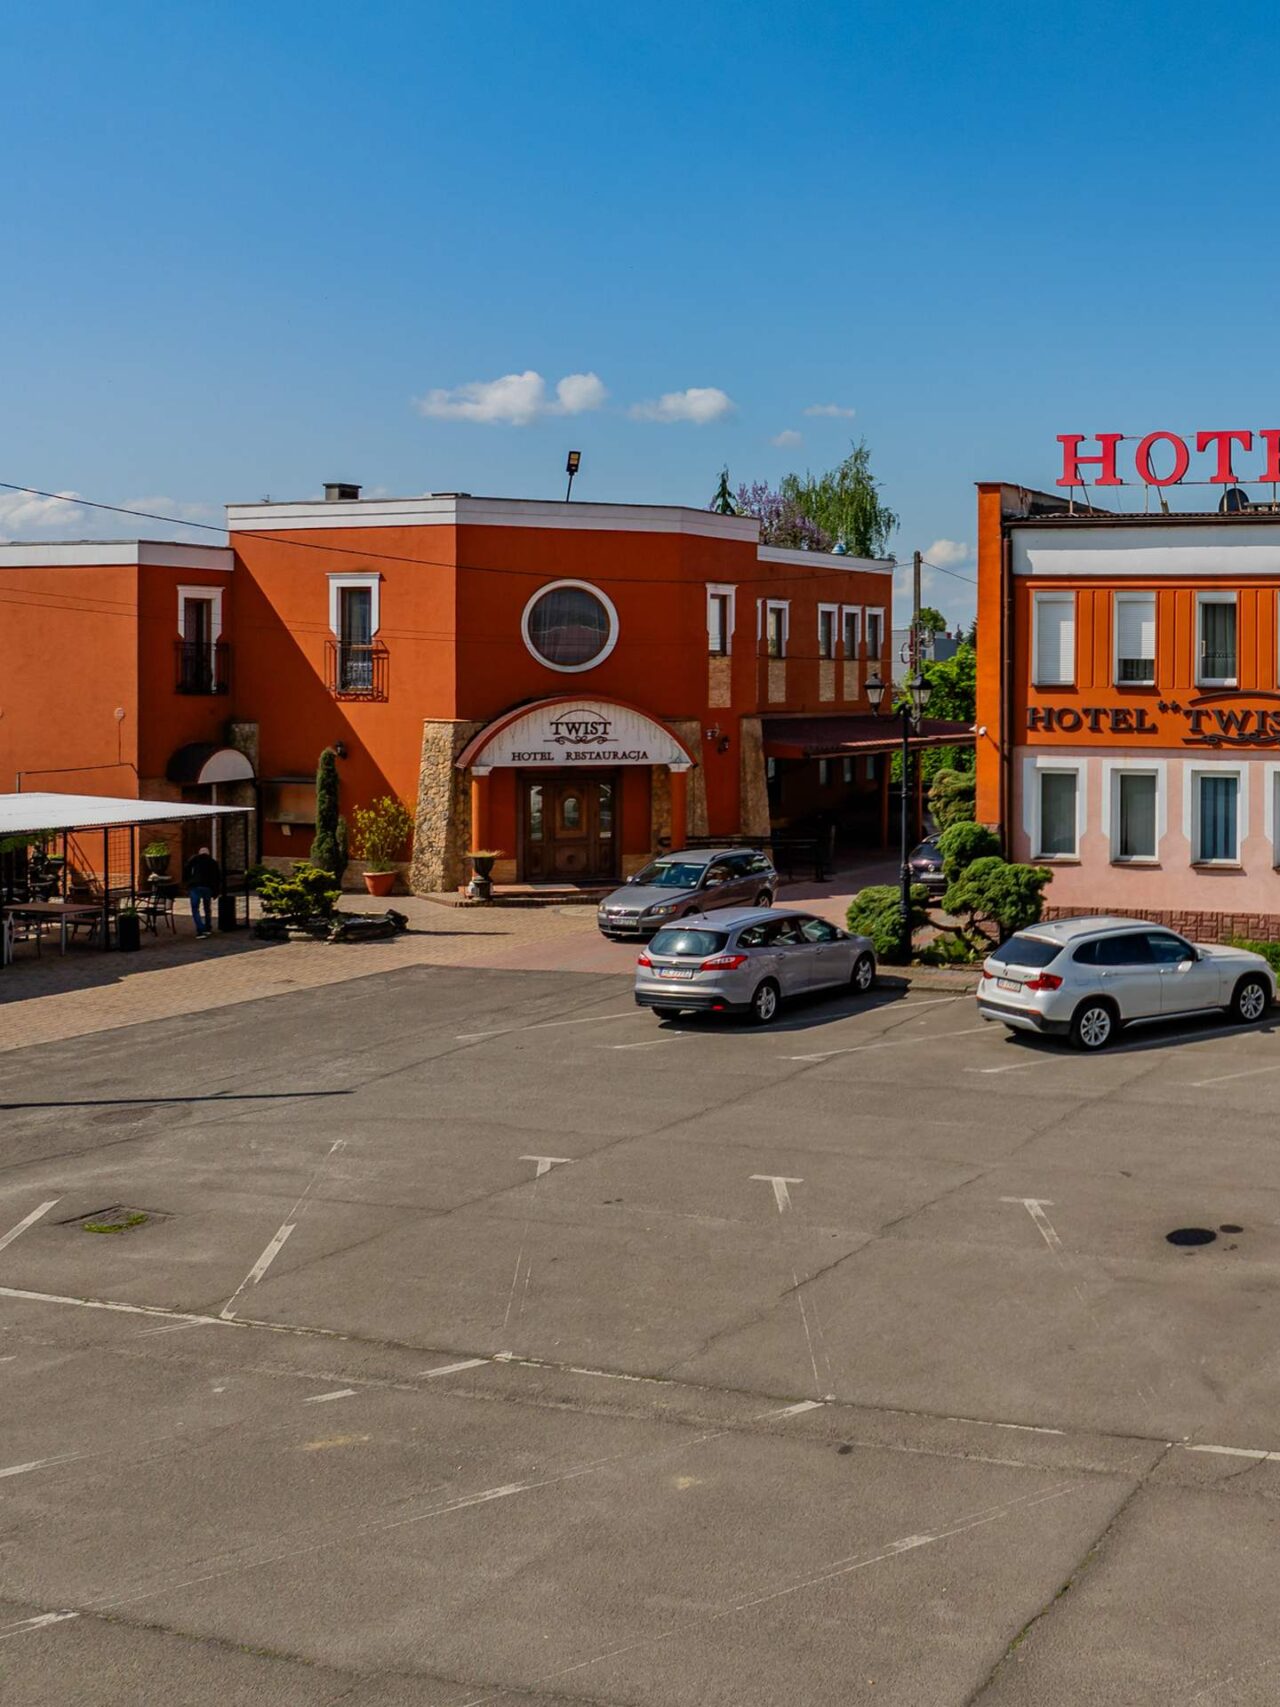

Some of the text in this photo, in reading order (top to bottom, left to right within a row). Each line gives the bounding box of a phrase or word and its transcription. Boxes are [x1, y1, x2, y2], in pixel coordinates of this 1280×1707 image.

[1026, 707, 1158, 733] HOTEL
[551, 721, 611, 735] TWIST
[512, 750, 649, 762] HOTEL RESTAURACJA
